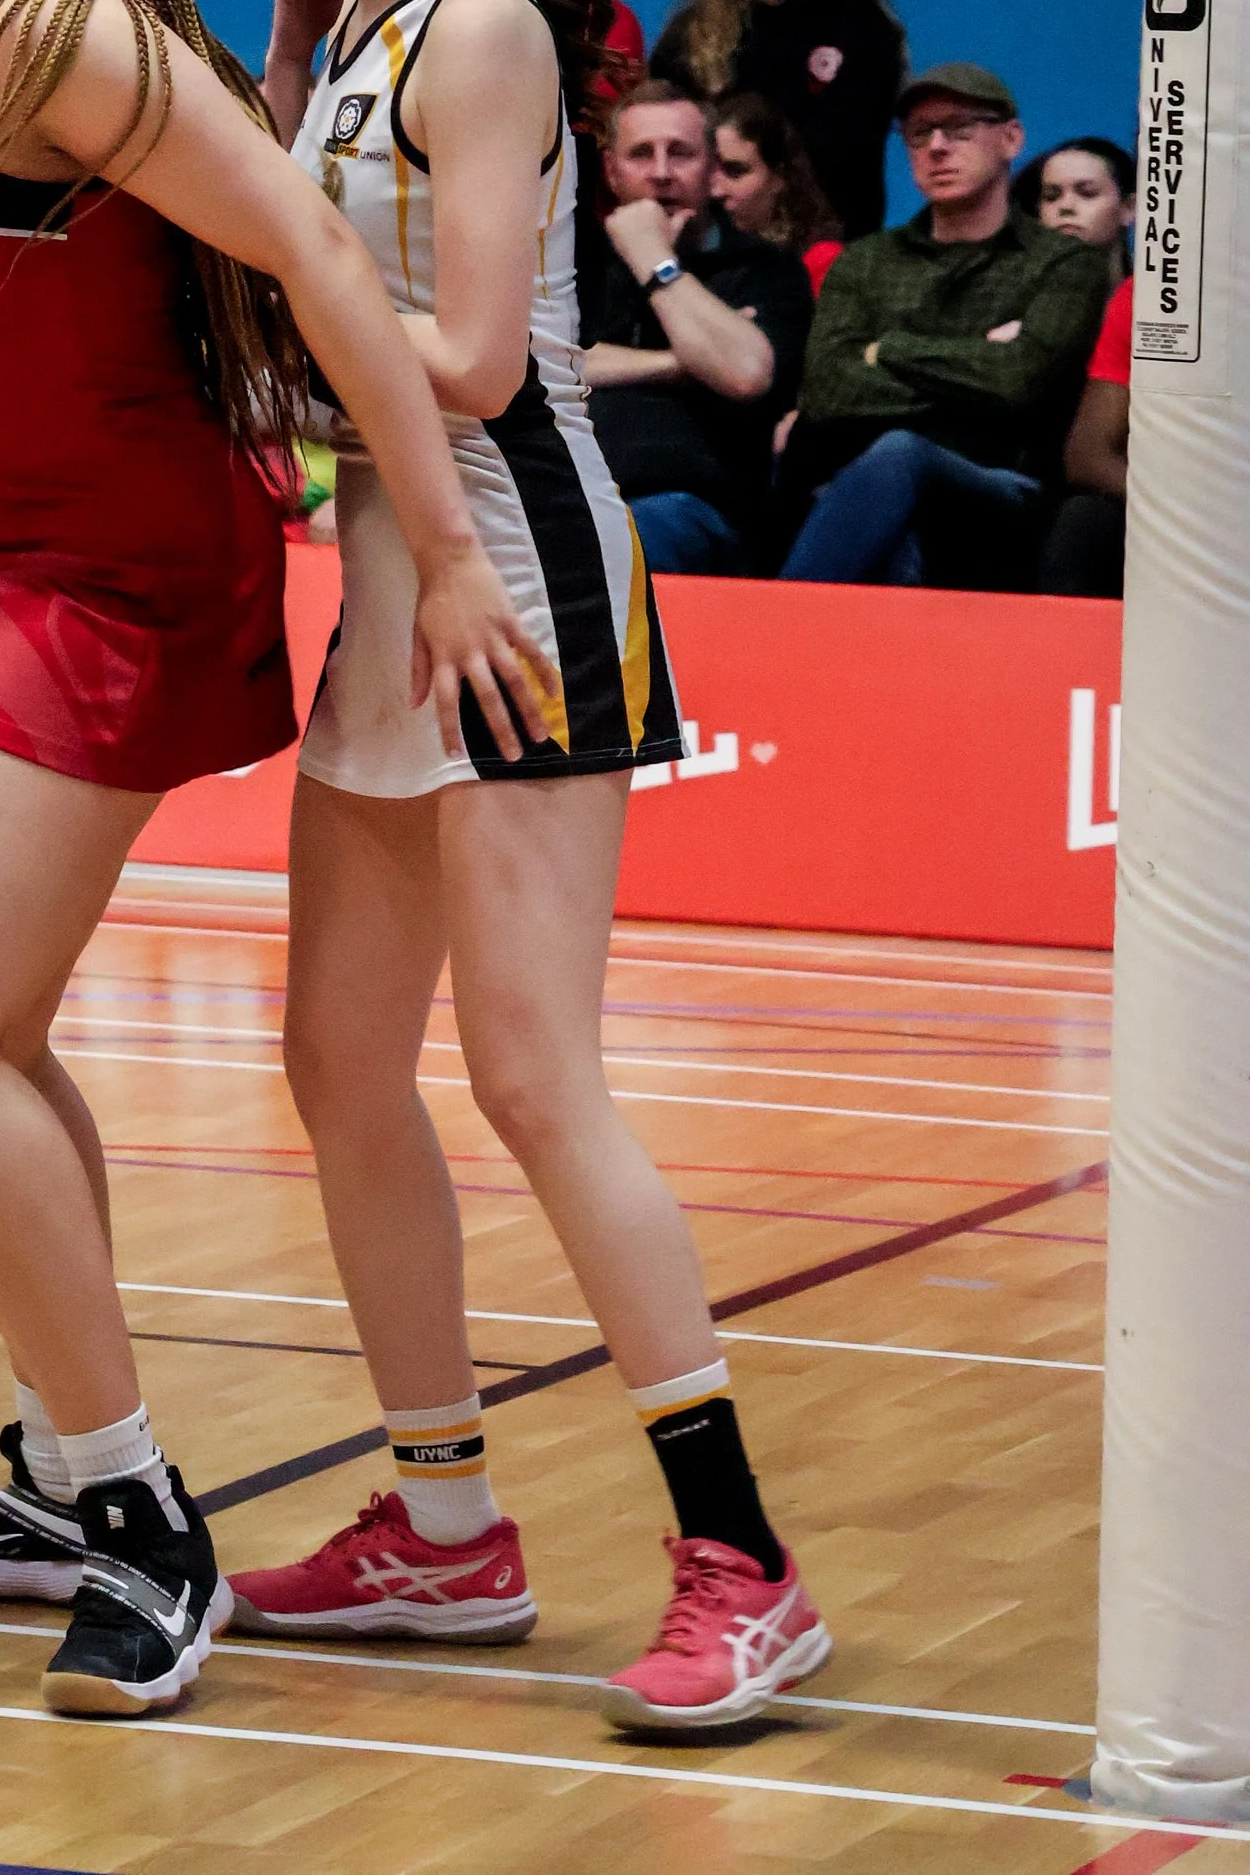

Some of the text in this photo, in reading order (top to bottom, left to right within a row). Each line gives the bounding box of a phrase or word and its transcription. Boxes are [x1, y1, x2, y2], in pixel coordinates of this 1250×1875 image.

[360, 150, 390, 162] UNION
[1159, 80, 1185, 314] SERVICES
[414, 1445, 462, 1461] UYNC
